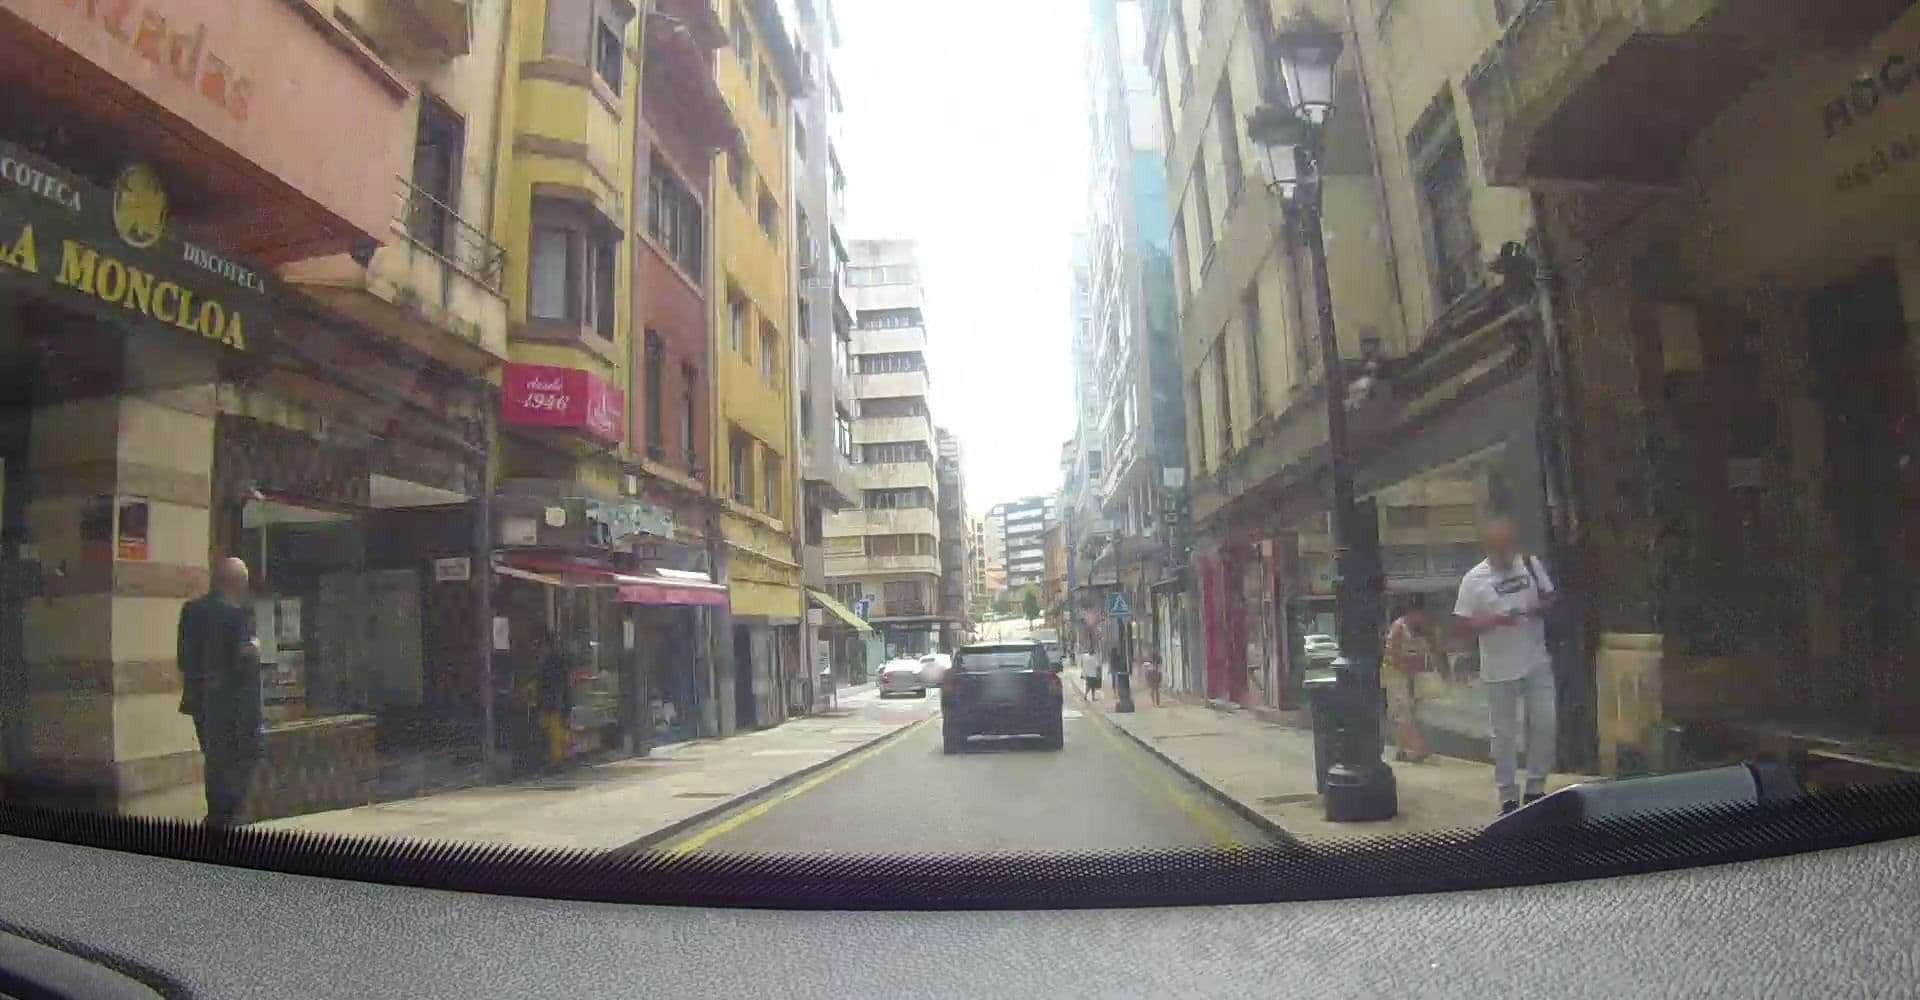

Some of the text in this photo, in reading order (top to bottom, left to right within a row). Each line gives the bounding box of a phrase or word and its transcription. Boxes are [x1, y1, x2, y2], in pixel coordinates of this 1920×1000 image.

[0, 223, 244, 350] A MONCLOA
[184, 240, 265, 295] DISCOTECA
[523, 393, 569, 411] 1946
